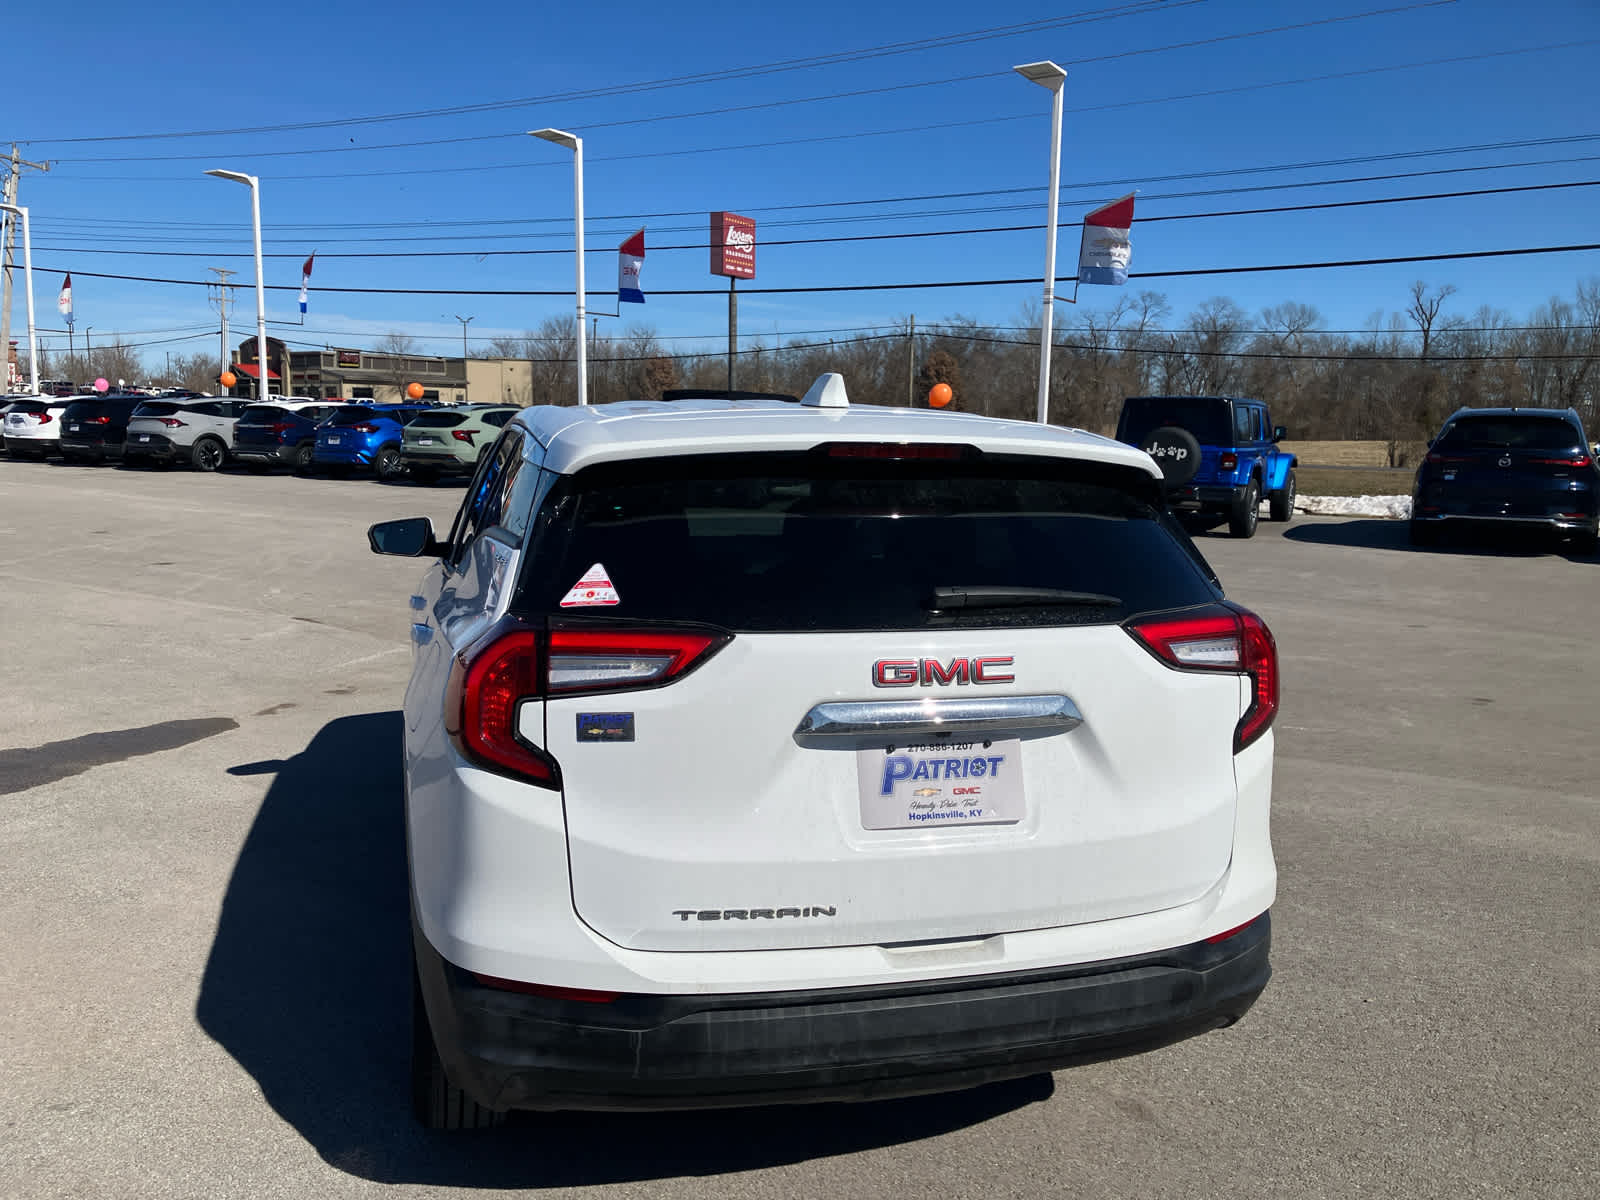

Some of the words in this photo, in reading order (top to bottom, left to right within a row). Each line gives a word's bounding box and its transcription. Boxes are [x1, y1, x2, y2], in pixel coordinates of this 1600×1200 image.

[872, 656, 1016, 688] GMC
[953, 786, 982, 796] GMC
[908, 811, 968, 822] Hopkinsville,
[969, 809, 983, 817] KY
[671, 905, 837, 921] TERRAIN
